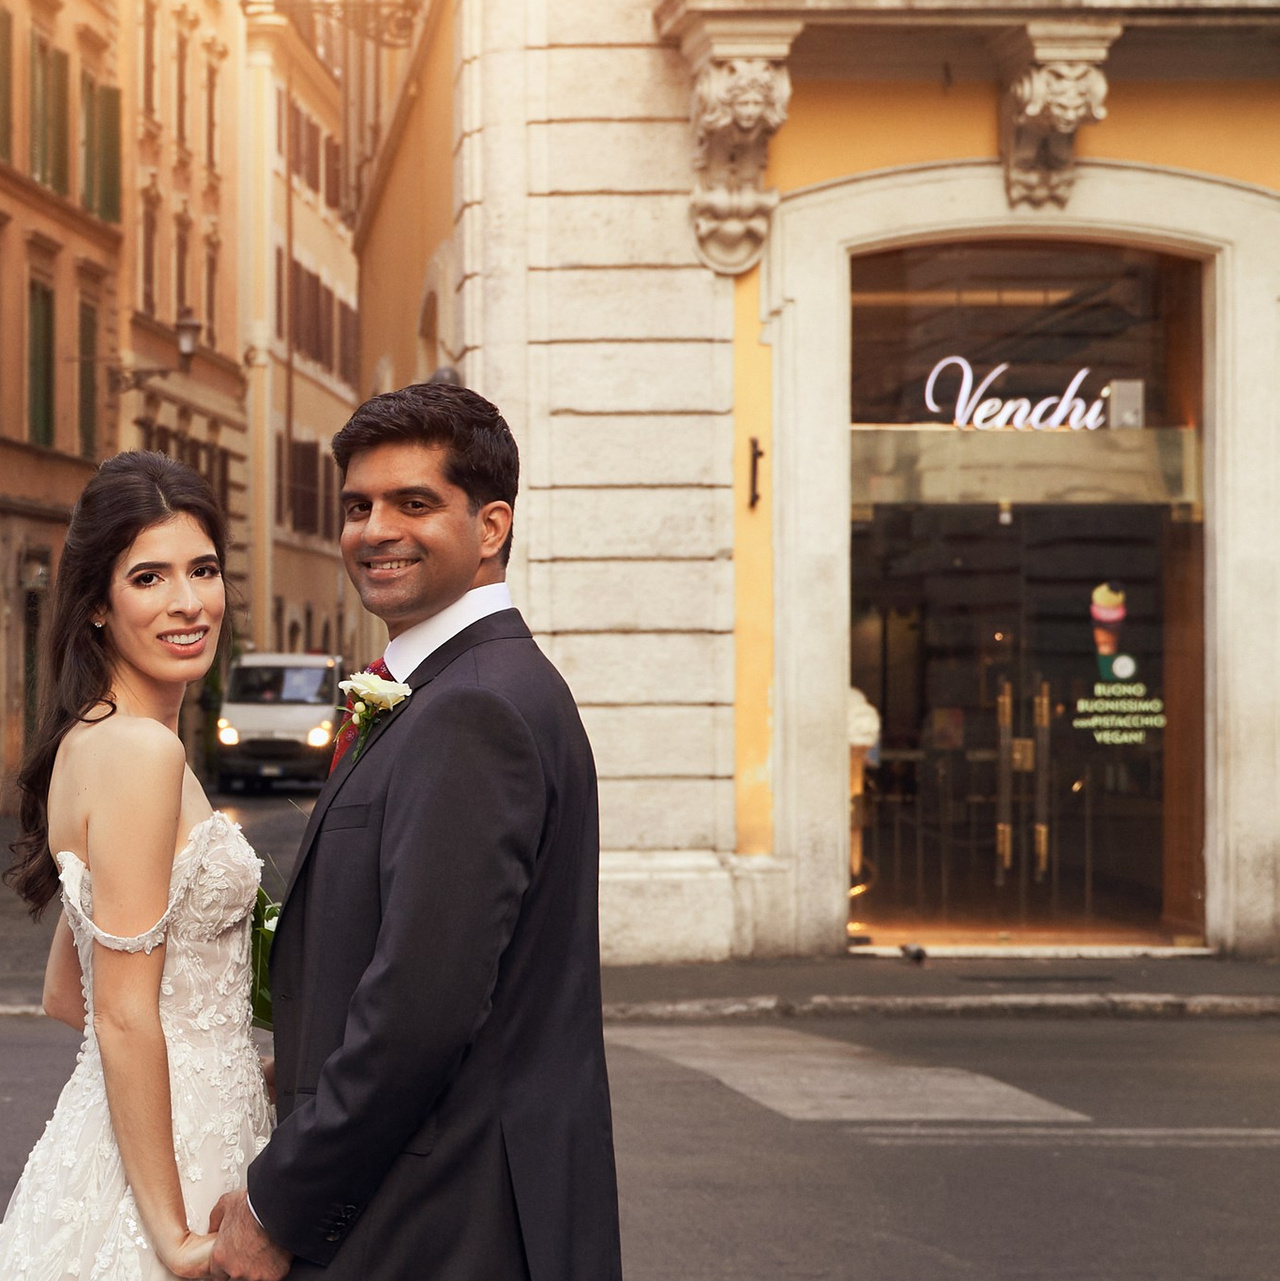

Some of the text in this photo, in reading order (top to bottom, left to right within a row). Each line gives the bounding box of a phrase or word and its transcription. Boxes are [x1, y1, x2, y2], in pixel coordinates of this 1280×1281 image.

[924, 355, 1111, 431] Venchi
[1094, 683, 1147, 697] BUONO
[1077, 699, 1163, 713] BUONISSIMO
